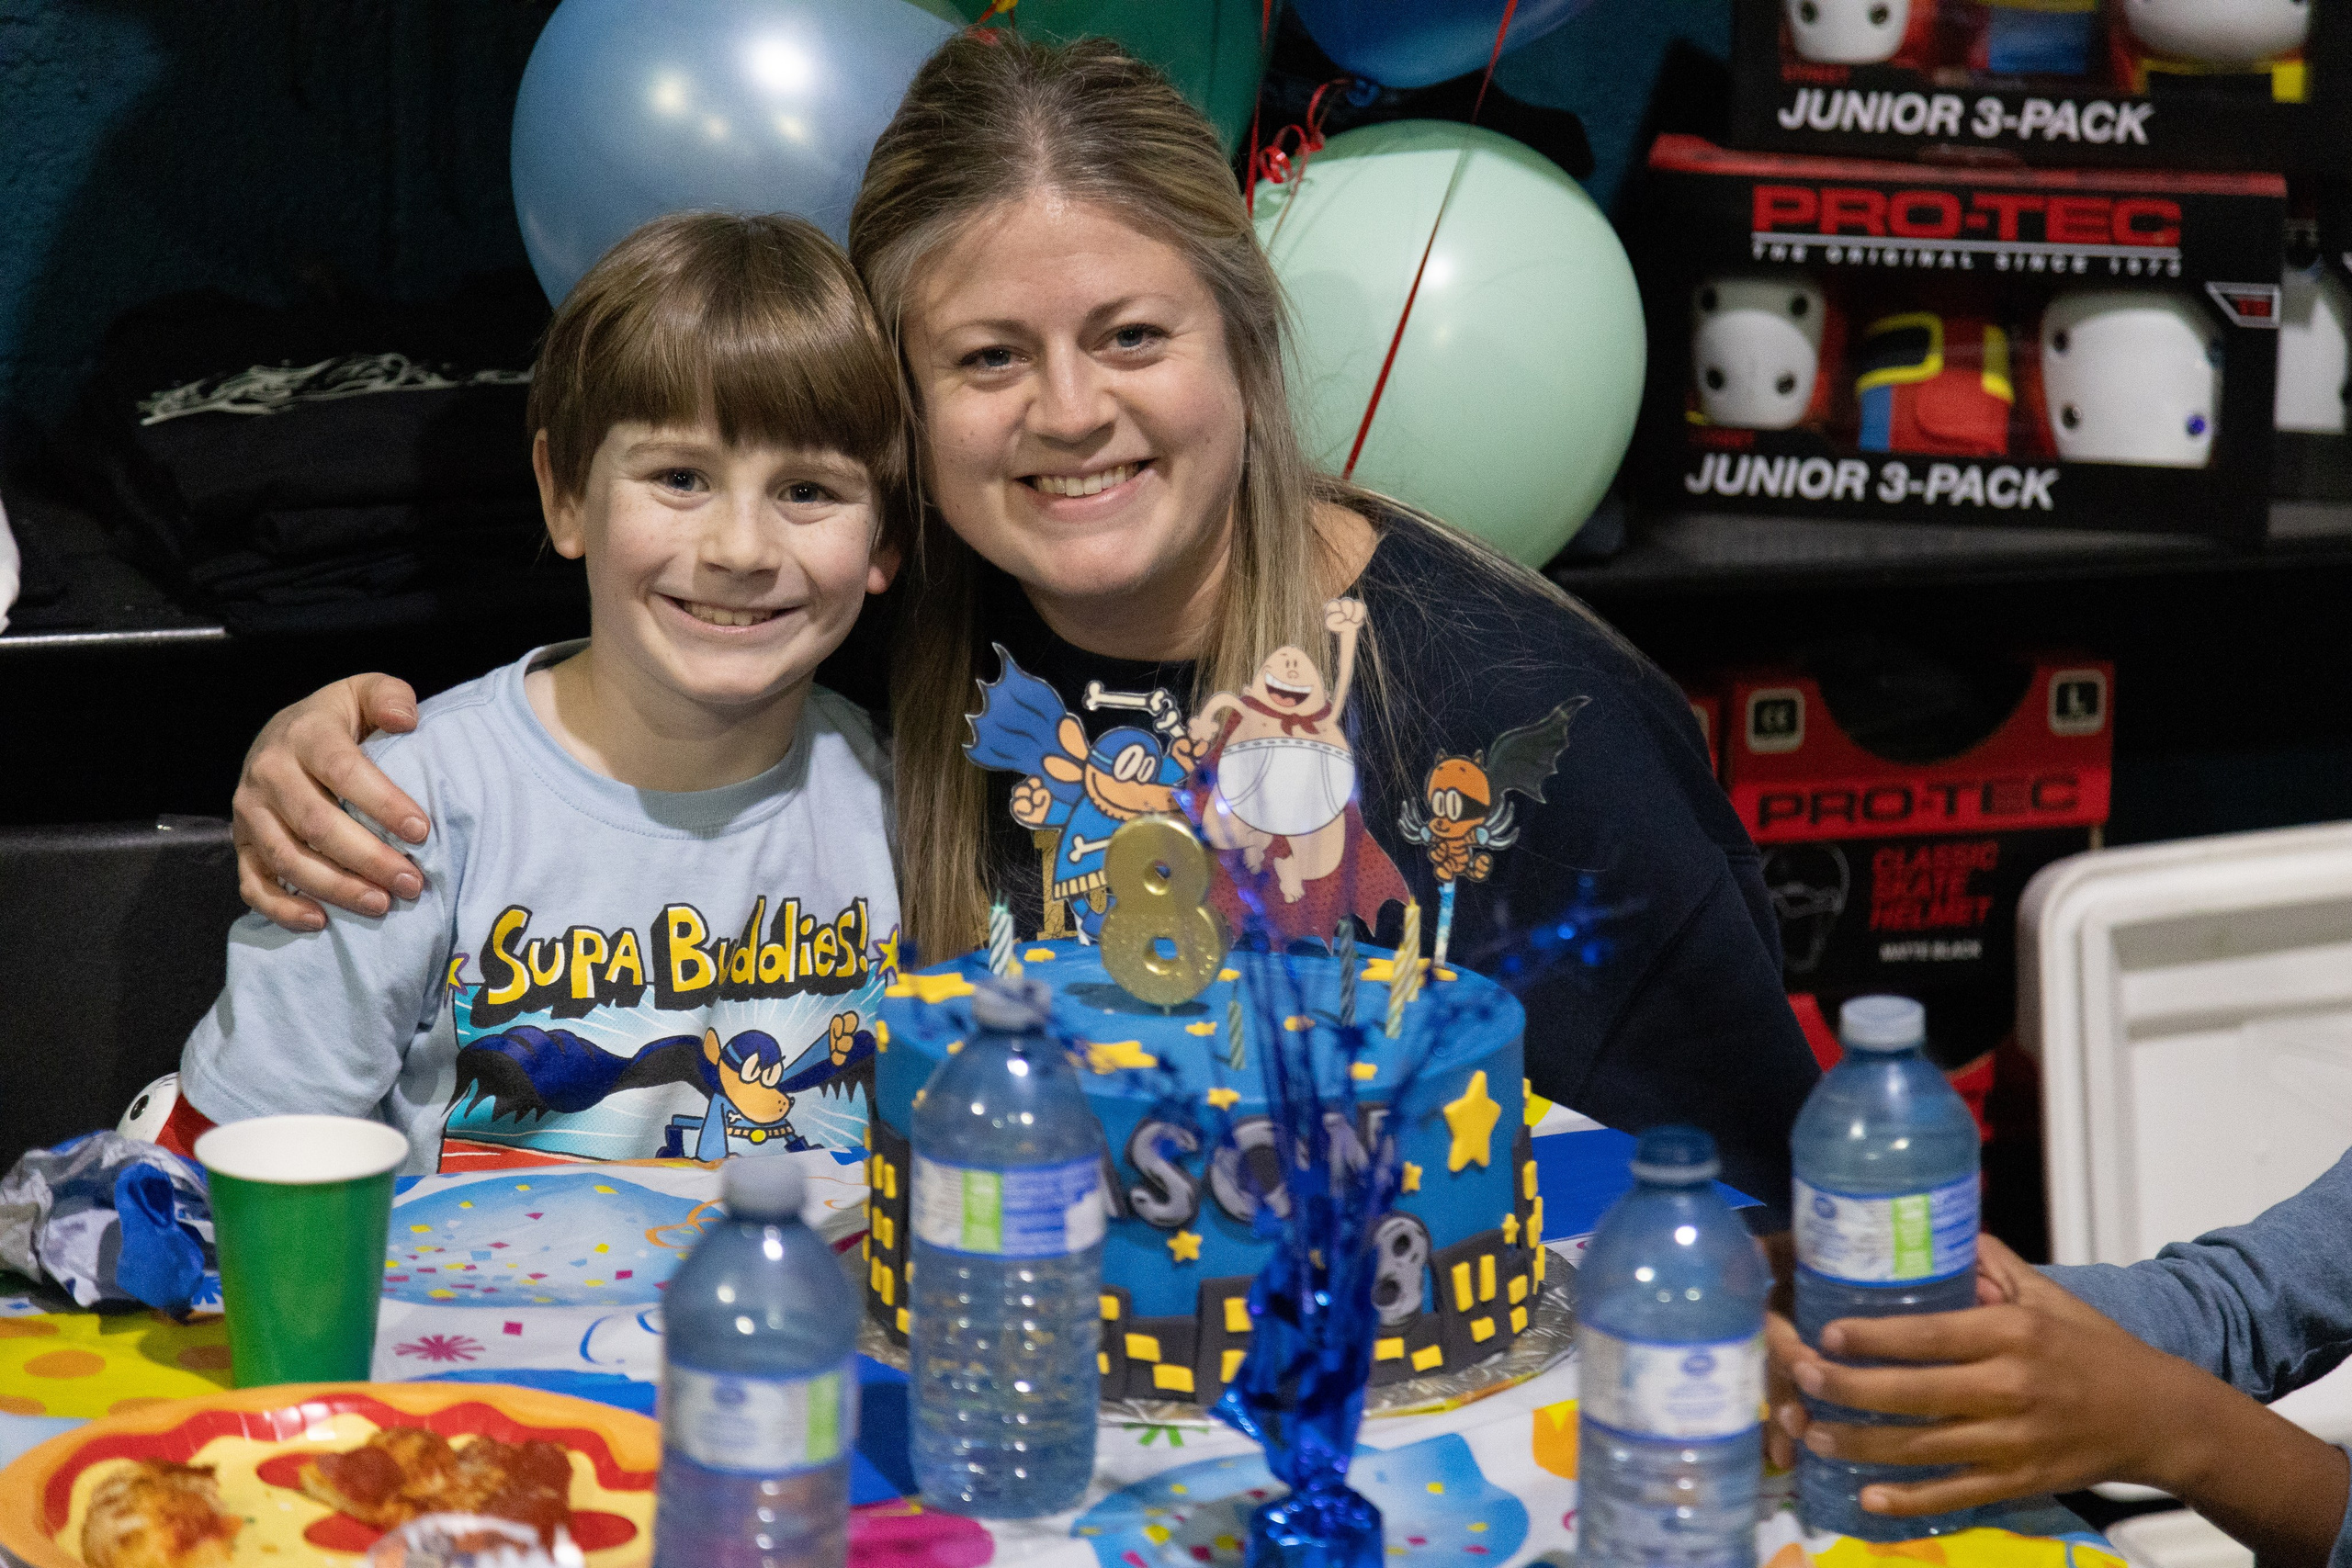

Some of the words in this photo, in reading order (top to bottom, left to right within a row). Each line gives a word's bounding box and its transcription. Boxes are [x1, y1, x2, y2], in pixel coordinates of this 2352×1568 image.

[1778, 88, 1965, 136] JUNIOR
[1972, 96, 2154, 145] 3-PACK
[1752, 185, 2182, 246] PRO-TEC
[1753, 243, 1808, 264] THE
[1826, 246, 1974, 270] ORIGINAL
[1995, 254, 2088, 274] SINCE
[1684, 454, 1871, 502] JUNIOR
[1877, 461, 2060, 511] 3-PACK
[1758, 775, 2078, 829] PRO-TEC
[1100, 814, 1229, 1005] 8
[655, 896, 869, 1007] Buddies!
[1930, 939, 1983, 961] BLACK
